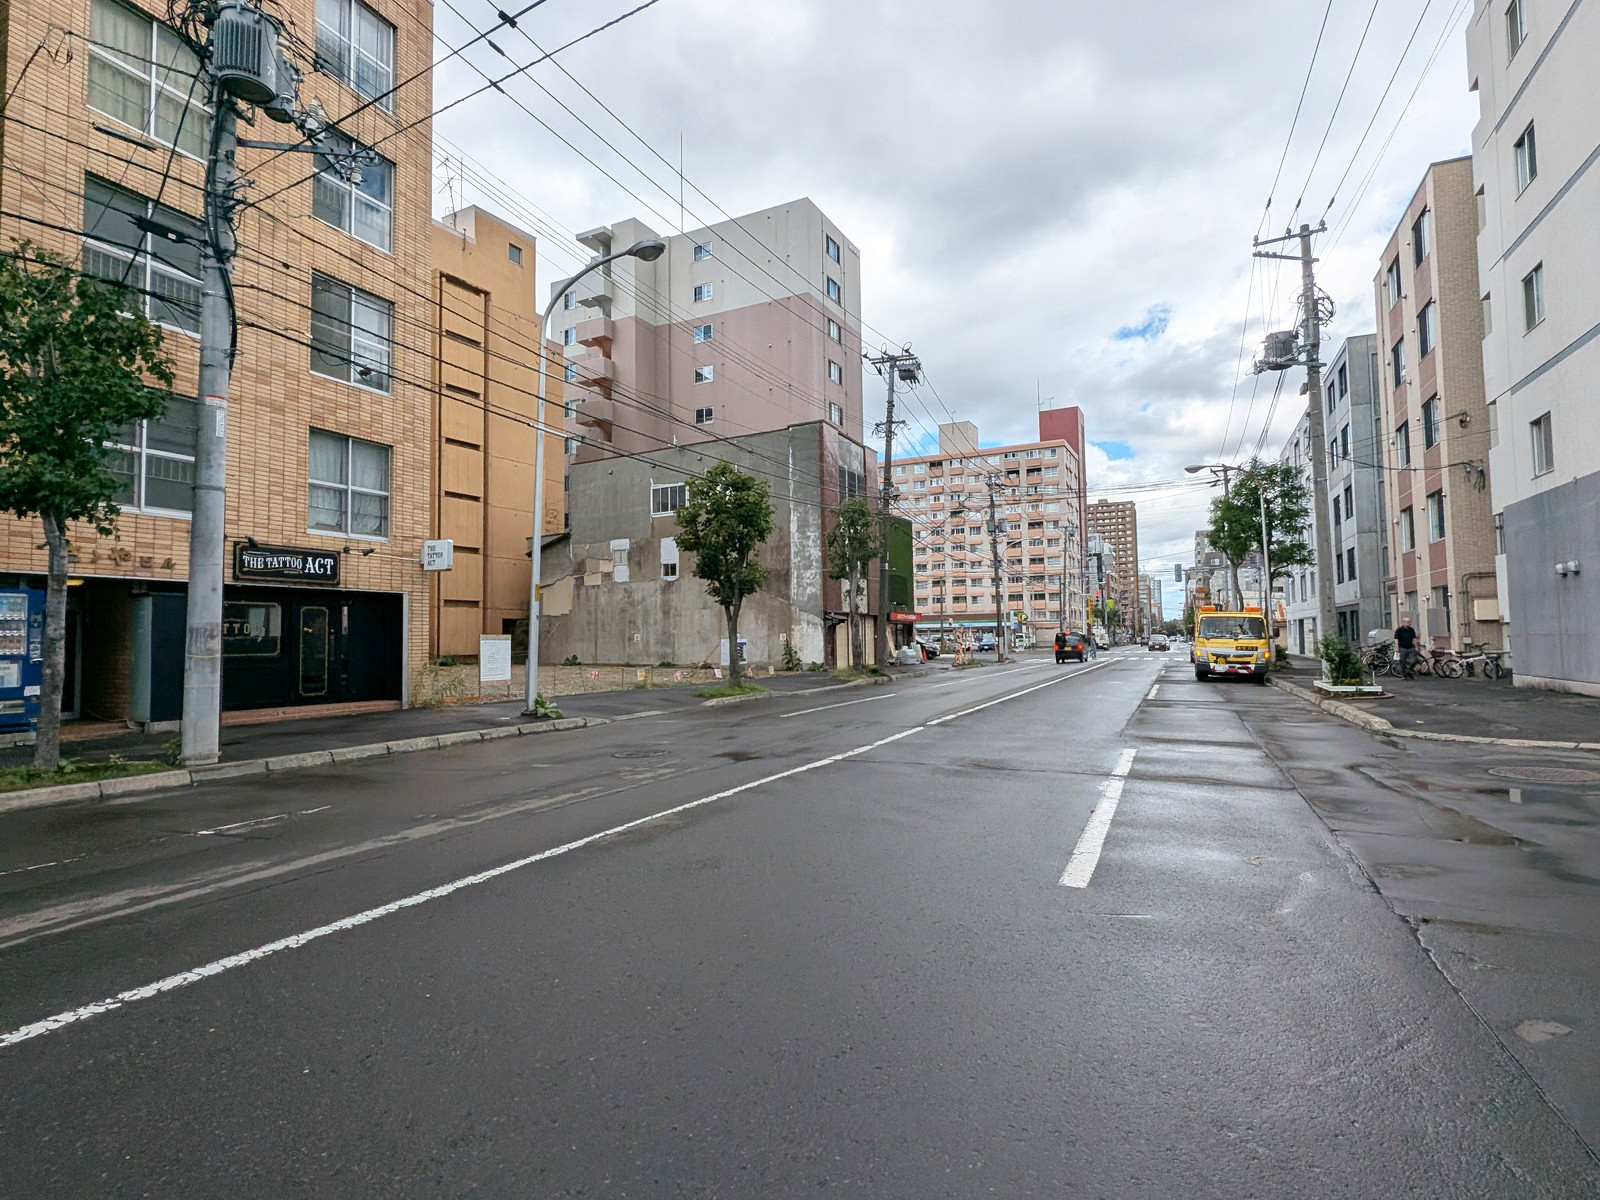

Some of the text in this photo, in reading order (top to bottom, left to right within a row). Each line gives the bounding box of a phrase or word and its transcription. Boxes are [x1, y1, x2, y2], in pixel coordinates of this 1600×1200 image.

[242, 555, 334, 575] THE TATTOO ACT
[427, 559, 437, 567] ACT
[223, 623, 260, 635] TTOO
